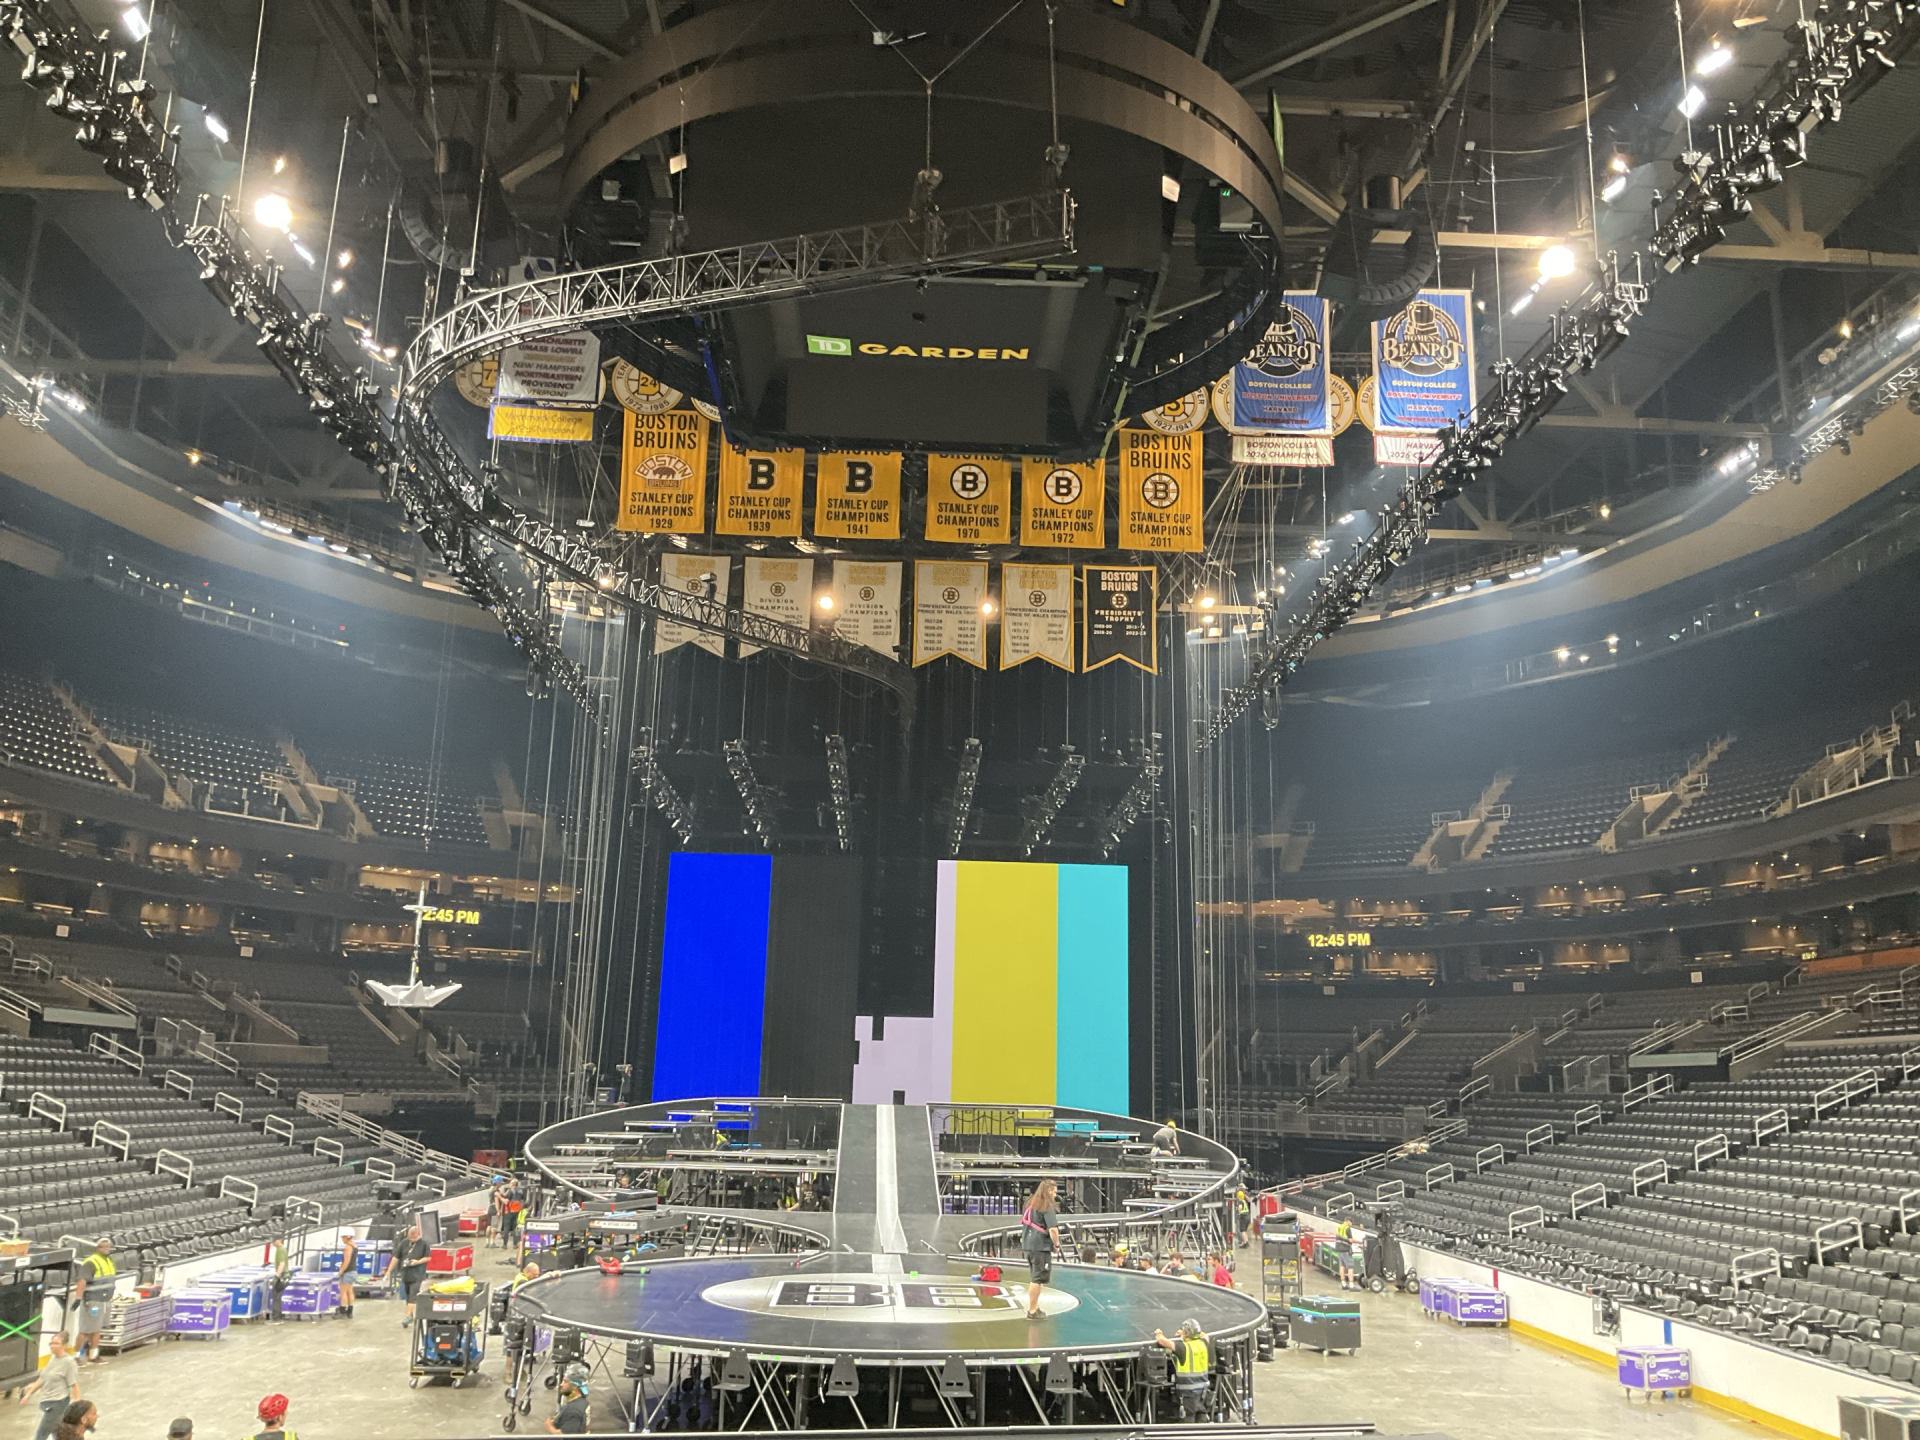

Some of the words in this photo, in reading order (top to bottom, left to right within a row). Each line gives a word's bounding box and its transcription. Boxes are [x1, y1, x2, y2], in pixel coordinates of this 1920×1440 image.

[1266, 335, 1293, 343] MEN'S
[1404, 334, 1442, 342] WOMEN'S
[518, 344, 548, 353] UMASS
[551, 346, 583, 355] LOWELL
[811, 338, 847, 353] TD
[858, 343, 1029, 360] GARDEN
[1247, 340, 1321, 365] EANPOT
[1382, 337, 1465, 365] BEANPOT
[513, 361, 534, 369] NEW
[536, 363, 585, 373] HAMPSHIRE
[514, 370, 582, 382] NORTHEASTERN
[640, 376, 658, 388] 24
[521, 379, 575, 390] PROVIDENCE
[1392, 380, 1423, 388] BOSTON
[1424, 381, 1457, 389] COLLEGE
[527, 387, 569, 398] VERMONT
[1242, 392, 1273, 400] BOSTON
[1274, 394, 1317, 402] UNIVERSITY
[1387, 391, 1417, 399] BOSTON
[1419, 393, 1463, 401] UNIVERSITY
[1263, 405, 1298, 413] HARVARD
[1407, 404, 1444, 412] HARVARD
[506, 411, 548, 422] Merrimack
[552, 414, 583, 425] College
[635, 413, 698, 431] BOSTON
[531, 425, 575, 435] Champions
[634, 431, 697, 450] BRUINS
[1131, 433, 1192, 451] BOSTON
[1247, 441, 1281, 449] BOSTON
[1283, 441, 1318, 449] COLLEGE
[1130, 451, 1191, 469] BRUINS
[1246, 451, 1267, 459] 2026
[1268, 451, 1320, 459] CHAMPIONS
[1391, 451, 1410, 459] 2026
[637, 455, 692, 478] BOSTON
[748, 458, 775, 490] B
[846, 461, 873, 493] B
[961, 471, 979, 491] B
[1055, 476, 1072, 496] B
[1153, 481, 1169, 500] B
[631, 491, 673, 504] STANLEY
[675, 493, 694, 504] CUP
[729, 495, 770, 507] STANLEY
[774, 497, 791, 508] CUP
[827, 498, 868, 510] STANLEY
[870, 499, 889, 510] CUP
[938, 503, 979, 514] STANLEY
[981, 504, 999, 515] CUP
[629, 505, 694, 517] CHAMPIONS
[728, 508, 791, 520] CHAMPIONS
[826, 511, 889, 523] CHAMPIONS
[1032, 507, 1073, 519] STANLEY
[1075, 509, 1094, 520] CUP
[1130, 511, 1172, 523] STANLEY
[1173, 513, 1191, 523] CUP
[650, 518, 673, 529] 1929
[748, 521, 771, 531] 1939
[937, 515, 999, 527] CHAMPIONS
[1032, 520, 1094, 532] CHAMPIONS
[846, 524, 869, 535] 1941
[957, 528, 980, 539] 1970
[1130, 523, 1192, 536] CHAMPIONS
[1051, 533, 1074, 544] 1972
[1150, 537, 1172, 548] 2011
[1101, 571, 1138, 581] BOSTON
[1101, 581, 1138, 591] BRUINS
[456, 910, 480, 925] PM
[1308, 933, 1345, 947] 12:45
[1347, 933, 1371, 947] PM
